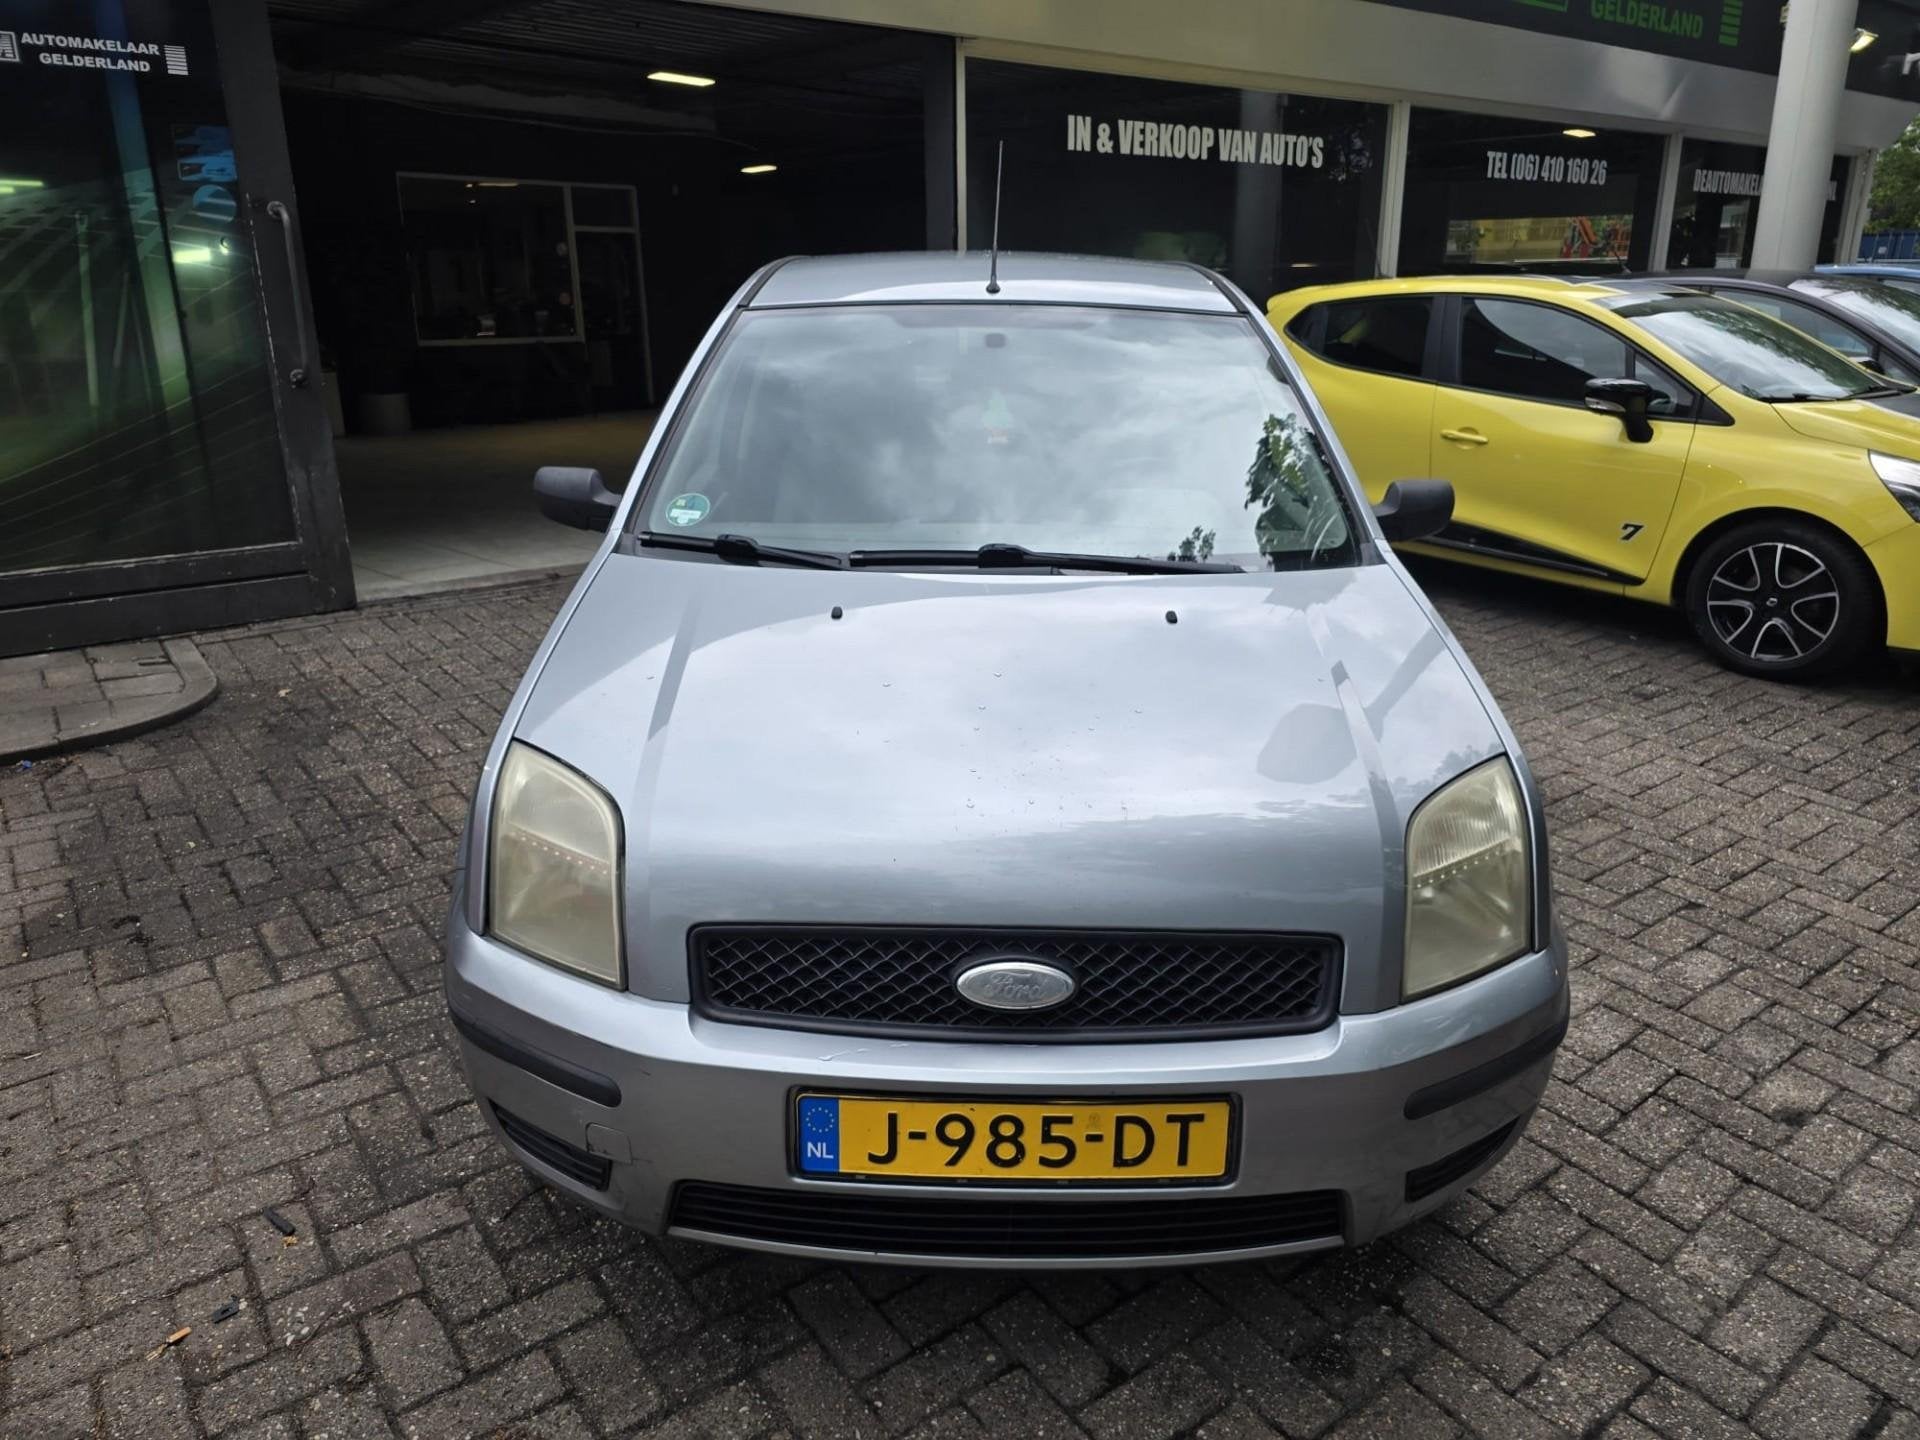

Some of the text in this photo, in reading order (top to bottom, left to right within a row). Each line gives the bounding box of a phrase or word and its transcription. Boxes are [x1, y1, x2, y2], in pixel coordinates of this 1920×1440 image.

[1591, 0, 1704, 39] GELDERLAND
[21, 32, 160, 56] AUTOMAKELAAR
[39, 52, 150, 73] GELDERLAND
[1067, 114, 1324, 168] IN & VERKOOP VAN AUTO'S
[1486, 150, 1608, 186] TEL (06) 410 160 26
[807, 1142, 834, 1160] NL
[867, 1112, 1205, 1168] J-985-DT
